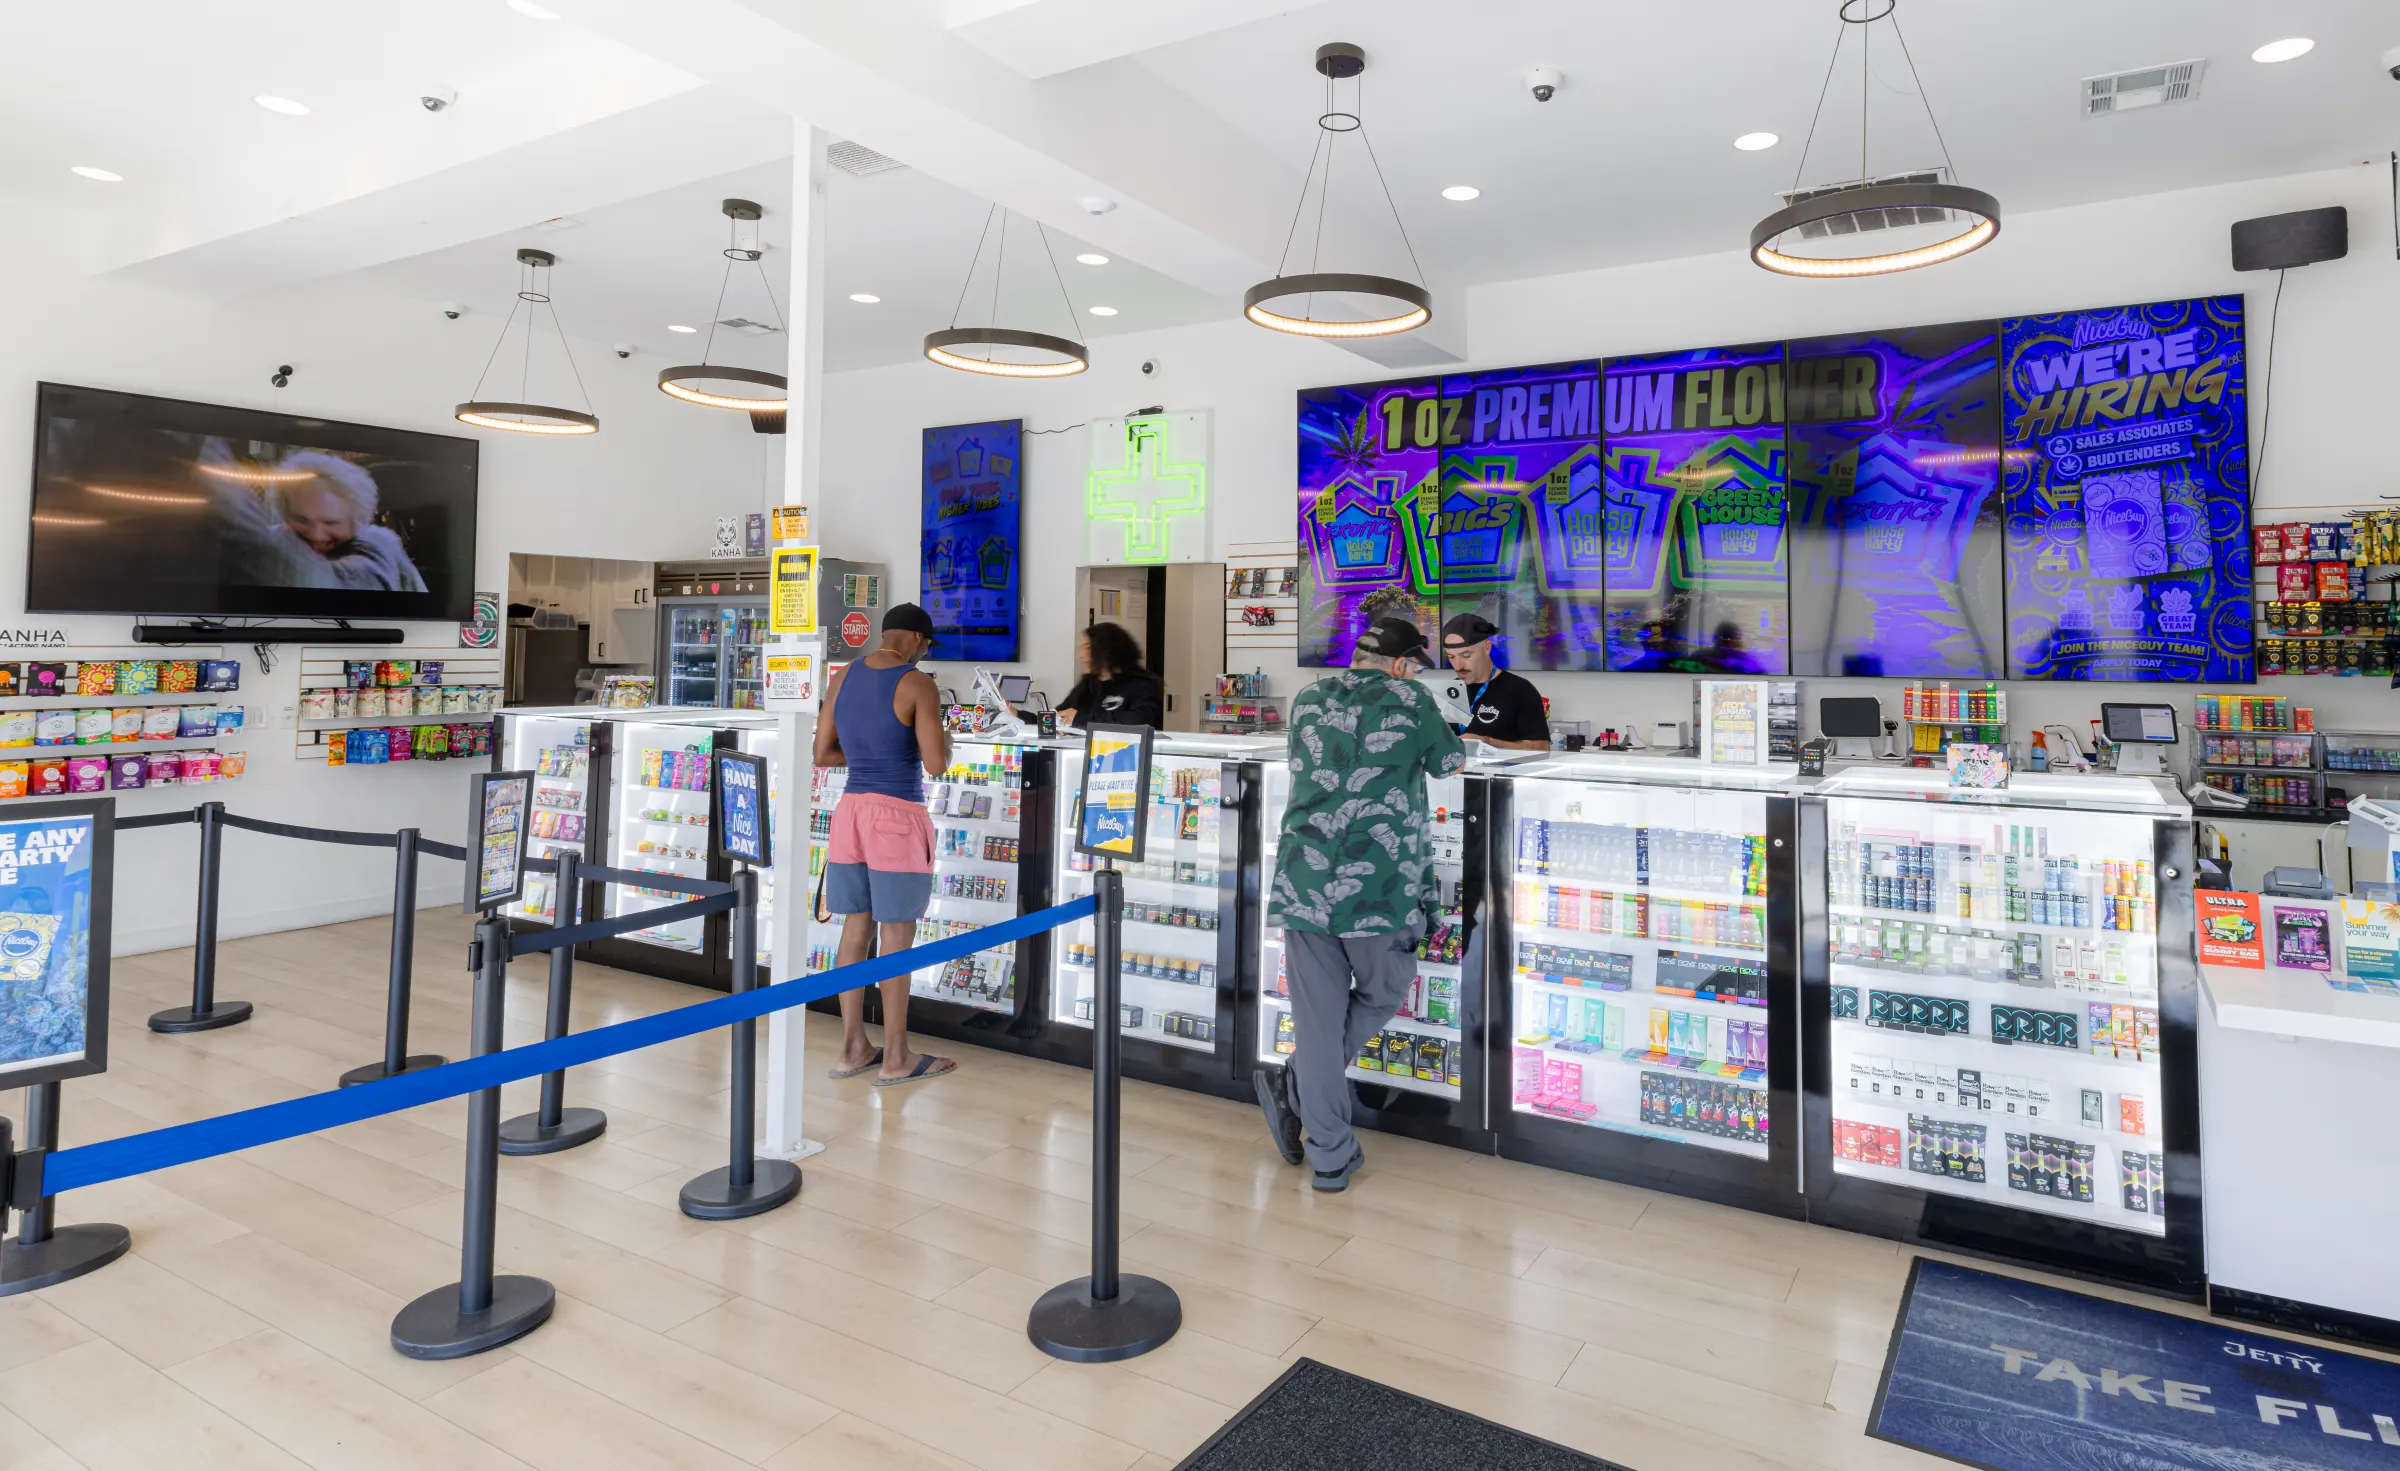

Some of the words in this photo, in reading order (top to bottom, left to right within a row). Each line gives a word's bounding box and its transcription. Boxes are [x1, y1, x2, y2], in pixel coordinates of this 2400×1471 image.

[2073, 315, 2149, 351] NiceGuy
[2029, 332, 2197, 394] WE'RE
[1383, 397, 1404, 450] 1
[1473, 373, 1676, 444] PREMIUM
[1684, 357, 1877, 430] FLOWER
[2014, 359, 2229, 442] HIRING
[2076, 432, 2115, 450] SALES
[2117, 419, 2194, 443] ASSOCIATES
[2087, 442, 2181, 468] BUDTENDERS
[1700, 488, 1784, 507] GREEN
[1697, 505, 1784, 527] HOUSE
[2105, 510, 2145, 528] NiceGuy
[2259, 530, 2282, 538] ULTRA
[2311, 527, 2335, 535] ULTRA
[712, 548, 741, 557] KANHA
[2161, 615, 2193, 623] GREAT
[843, 624, 869, 636] STARTS
[2163, 622, 2192, 630] TEAM
[2057, 643, 2085, 655] JOIN
[2087, 641, 2109, 651] THE
[2111, 640, 2164, 651] NICEGUY
[2167, 643, 2205, 655] TEAM!
[2093, 659, 2125, 668] APPLY
[2128, 658, 2162, 668] TODAY
[1450, 689, 1456, 697] 5
[1717, 708, 1752, 716] AUGUST
[724, 768, 757, 790] HAVE
[1088, 781, 1106, 791] PLEASE
[1107, 780, 1120, 791] WAIT
[1120, 779, 1134, 790] HERE
[737, 793, 746, 809] A
[493, 806, 513, 816] HOT
[489, 815, 516, 827] AUGUST
[733, 812, 752, 837] Nice
[1097, 814, 1124, 837] NiceGuy
[25, 827, 88, 849] ANY
[731, 835, 756, 856] DAY
[2205, 896, 2249, 908] ULTRA
[2345, 921, 2389, 931] Summer
[4, 932, 39, 949] NiceGuy
[2346, 929, 2368, 937] your
[2370, 931, 2391, 940] way
[2204, 947, 2238, 956] GUMMY
[1851, 1068, 1871, 1076] Garden
[1872, 1071, 1892, 1079] Garden
[1915, 1077, 1935, 1085] Garden
[1936, 1080, 1957, 1088] Garden
[1982, 1088, 2004, 1096] Garden
[2004, 1091, 2026, 1099] Garden
[2028, 1094, 2050, 1102] Garden
[2224, 1341, 2326, 1375] JETTY
[1990, 1344, 2217, 1414] TAKE
